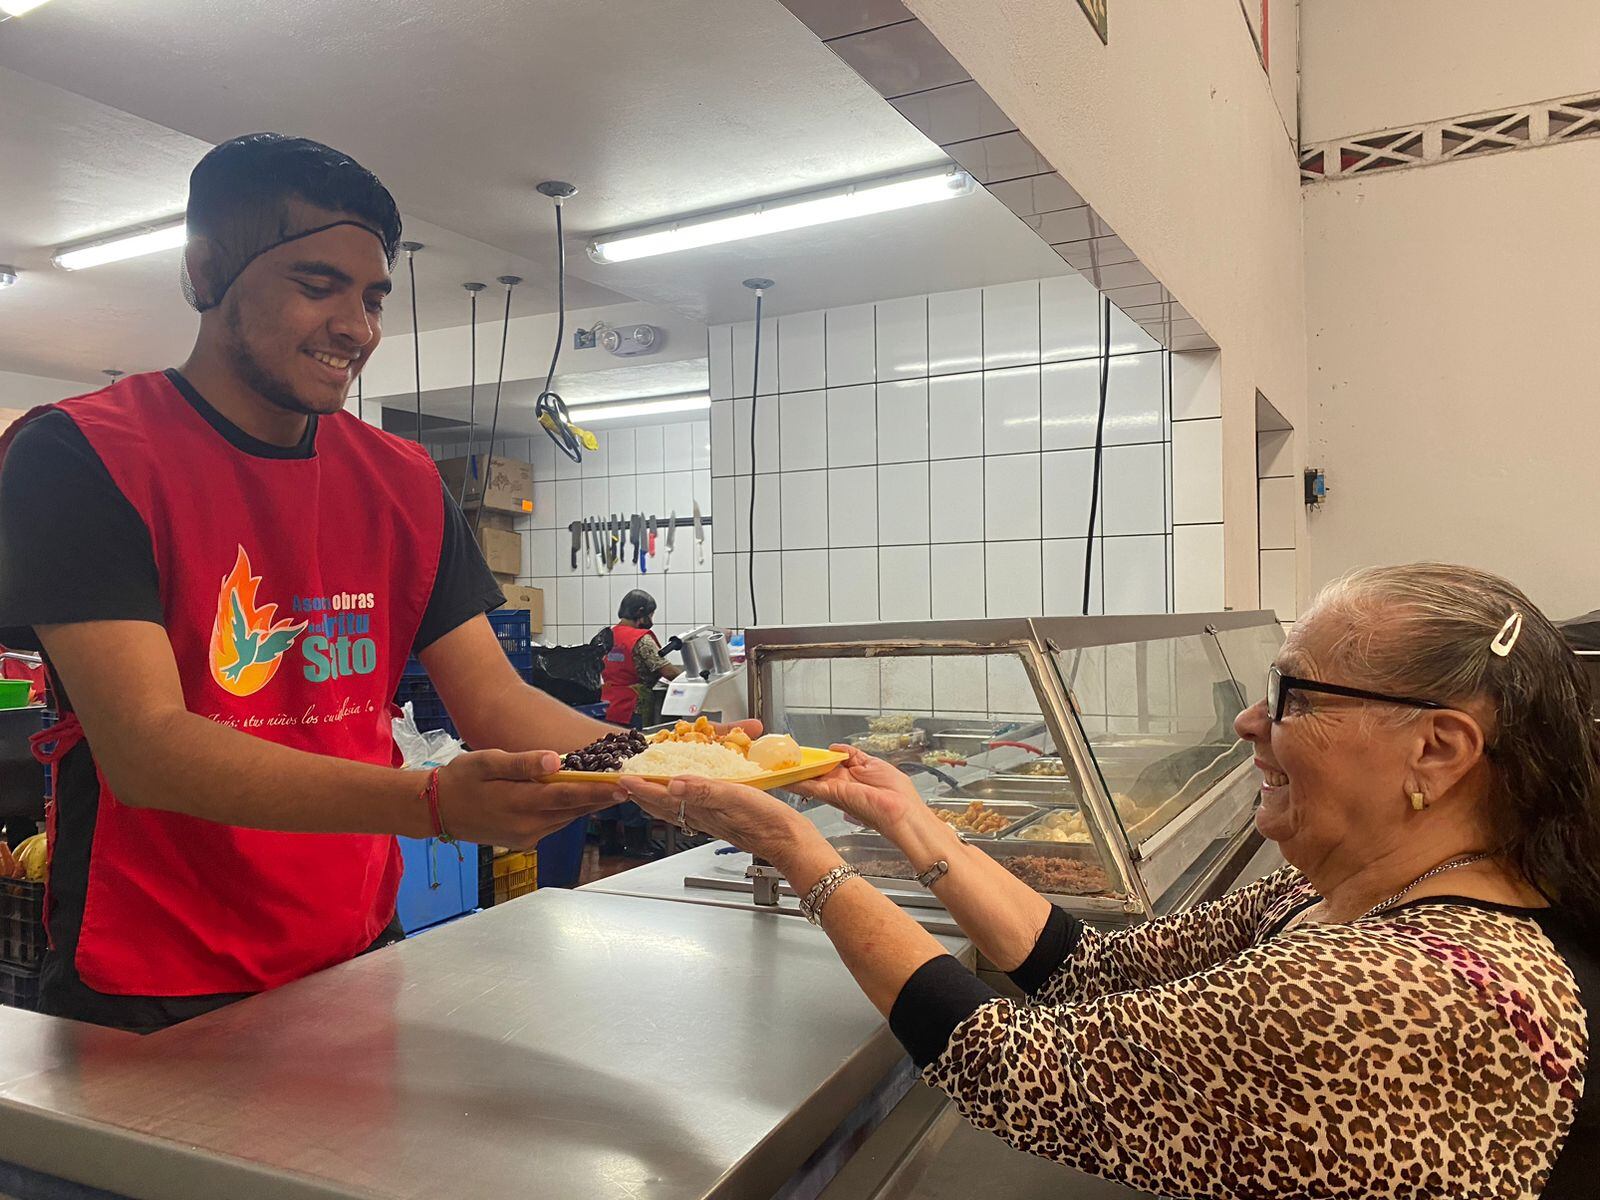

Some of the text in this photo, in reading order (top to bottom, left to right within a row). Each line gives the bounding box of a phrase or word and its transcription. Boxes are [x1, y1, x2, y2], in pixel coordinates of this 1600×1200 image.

[332, 591, 375, 611] obras
[266, 713, 298, 726] niños
[301, 703, 319, 724] los
